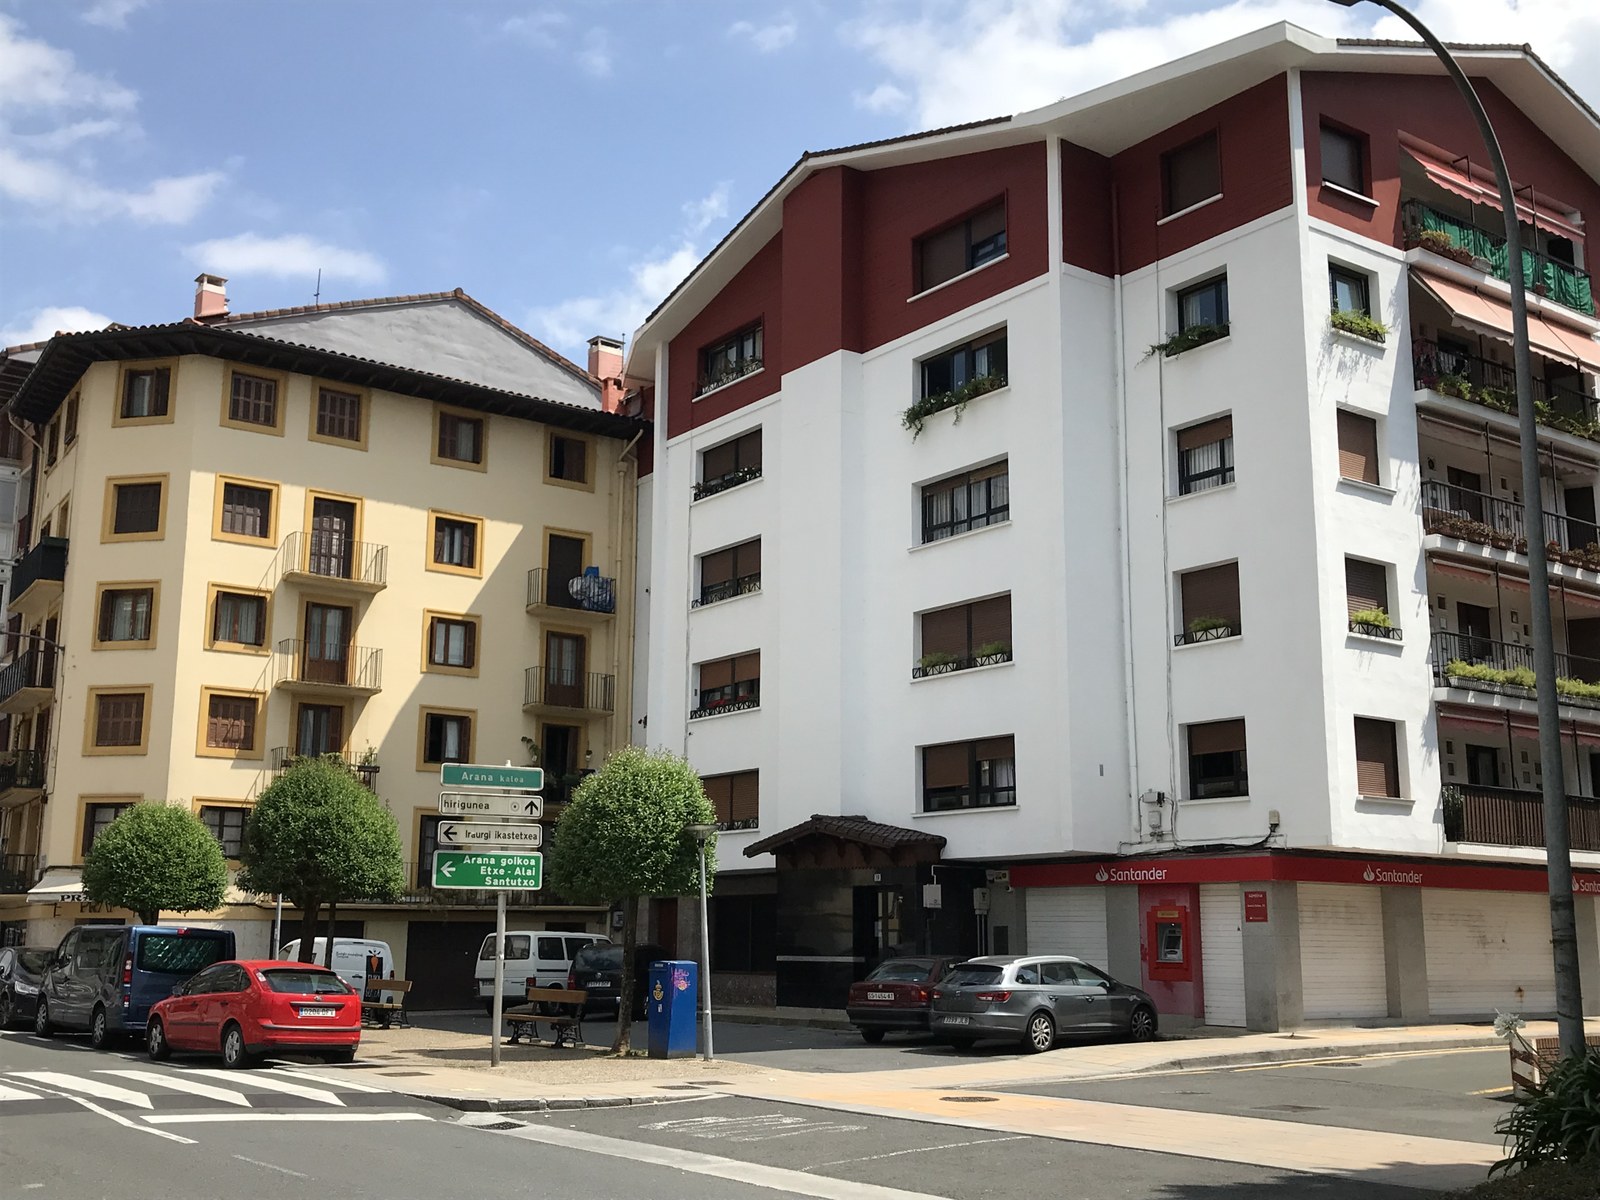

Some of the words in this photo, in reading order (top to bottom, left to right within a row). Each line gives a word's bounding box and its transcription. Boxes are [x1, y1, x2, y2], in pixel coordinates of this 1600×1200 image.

[461, 771, 494, 781] Arana
[499, 775, 524, 783] kalea
[443, 799, 490, 811] hirigunea
[465, 829, 491, 841] Iraurgi
[494, 830, 538, 841] ikastetxea
[463, 855, 496, 865] Arana
[500, 857, 536, 867] goikoa
[480, 866, 505, 876] Etxe
[514, 867, 536, 876] Alai
[1110, 867, 1168, 881] Santander
[1376, 868, 1423, 884] Santander
[484, 876, 536, 887] Santutxo
